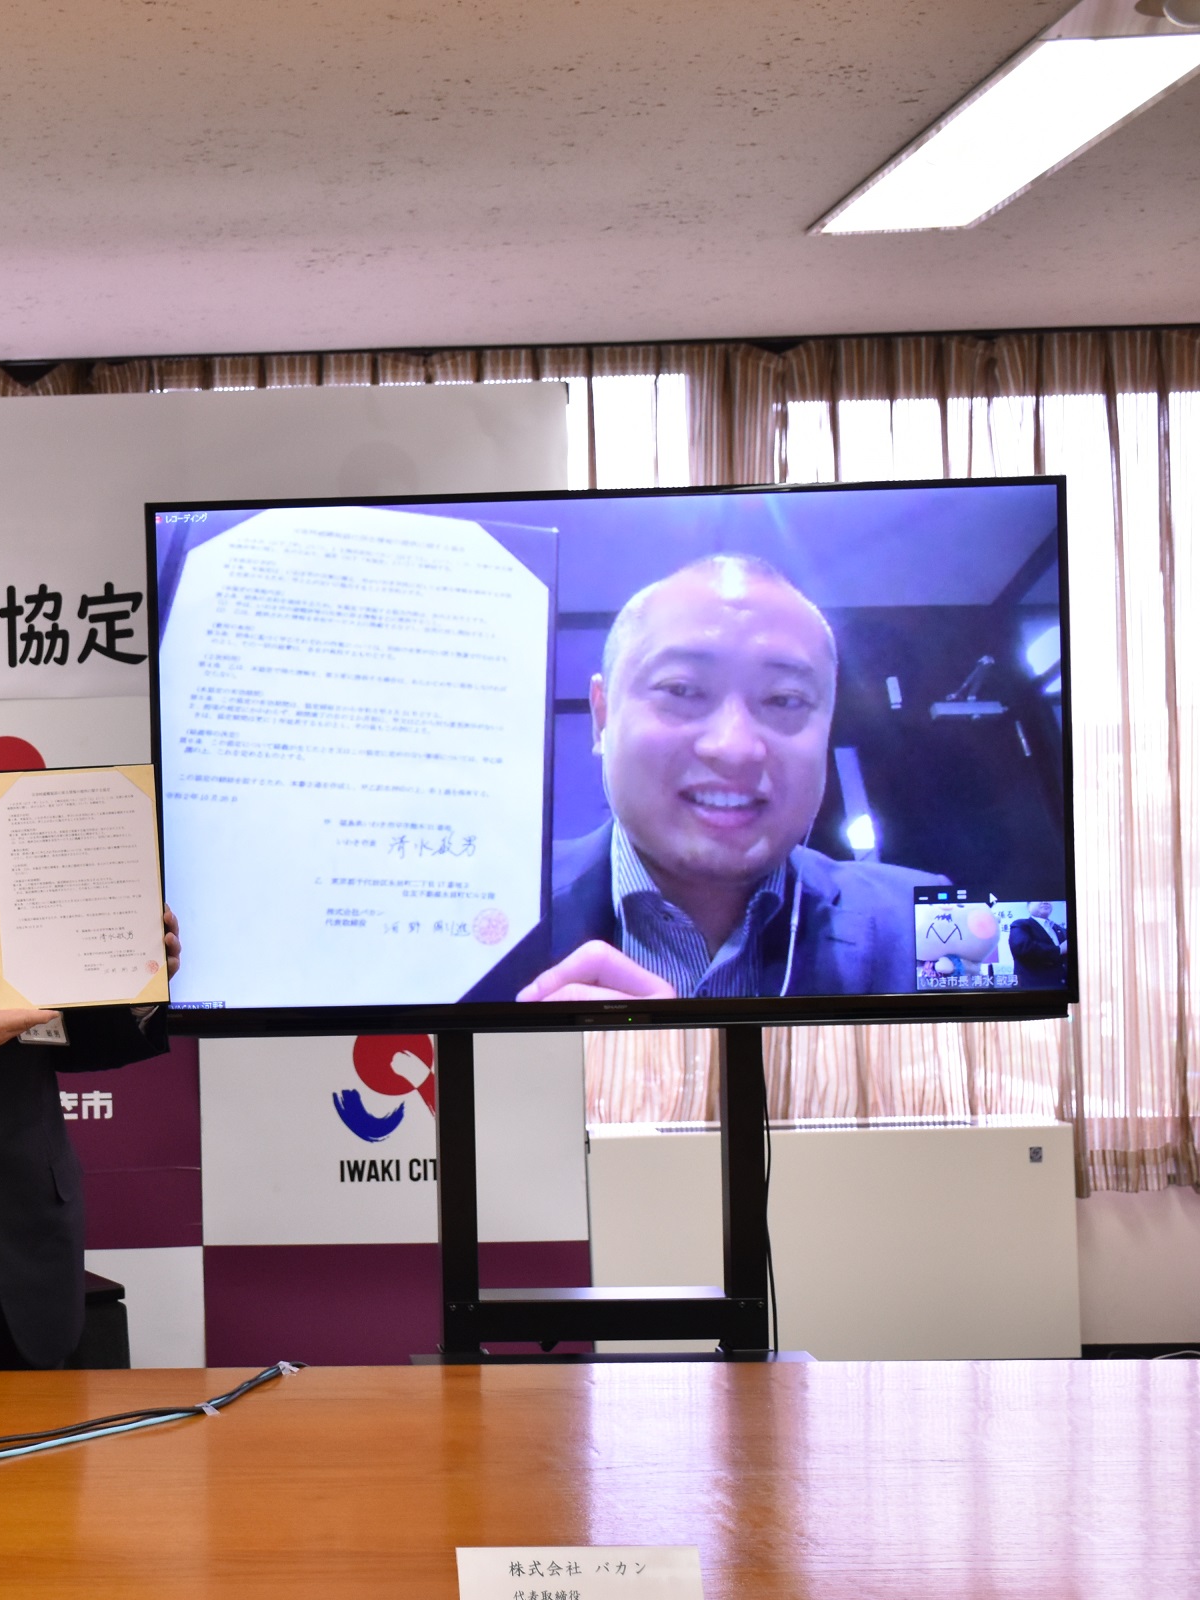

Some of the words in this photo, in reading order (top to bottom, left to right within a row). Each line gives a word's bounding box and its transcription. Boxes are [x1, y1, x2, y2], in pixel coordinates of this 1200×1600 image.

[165, 512, 208, 524] レコーディング
[919, 976, 969, 988] いわき市長
[971, 975, 994, 987] 清水
[340, 1159, 401, 1183] IWAKI
[508, 1560, 583, 1578] 株式会社
[595, 1560, 648, 1576] バカン
